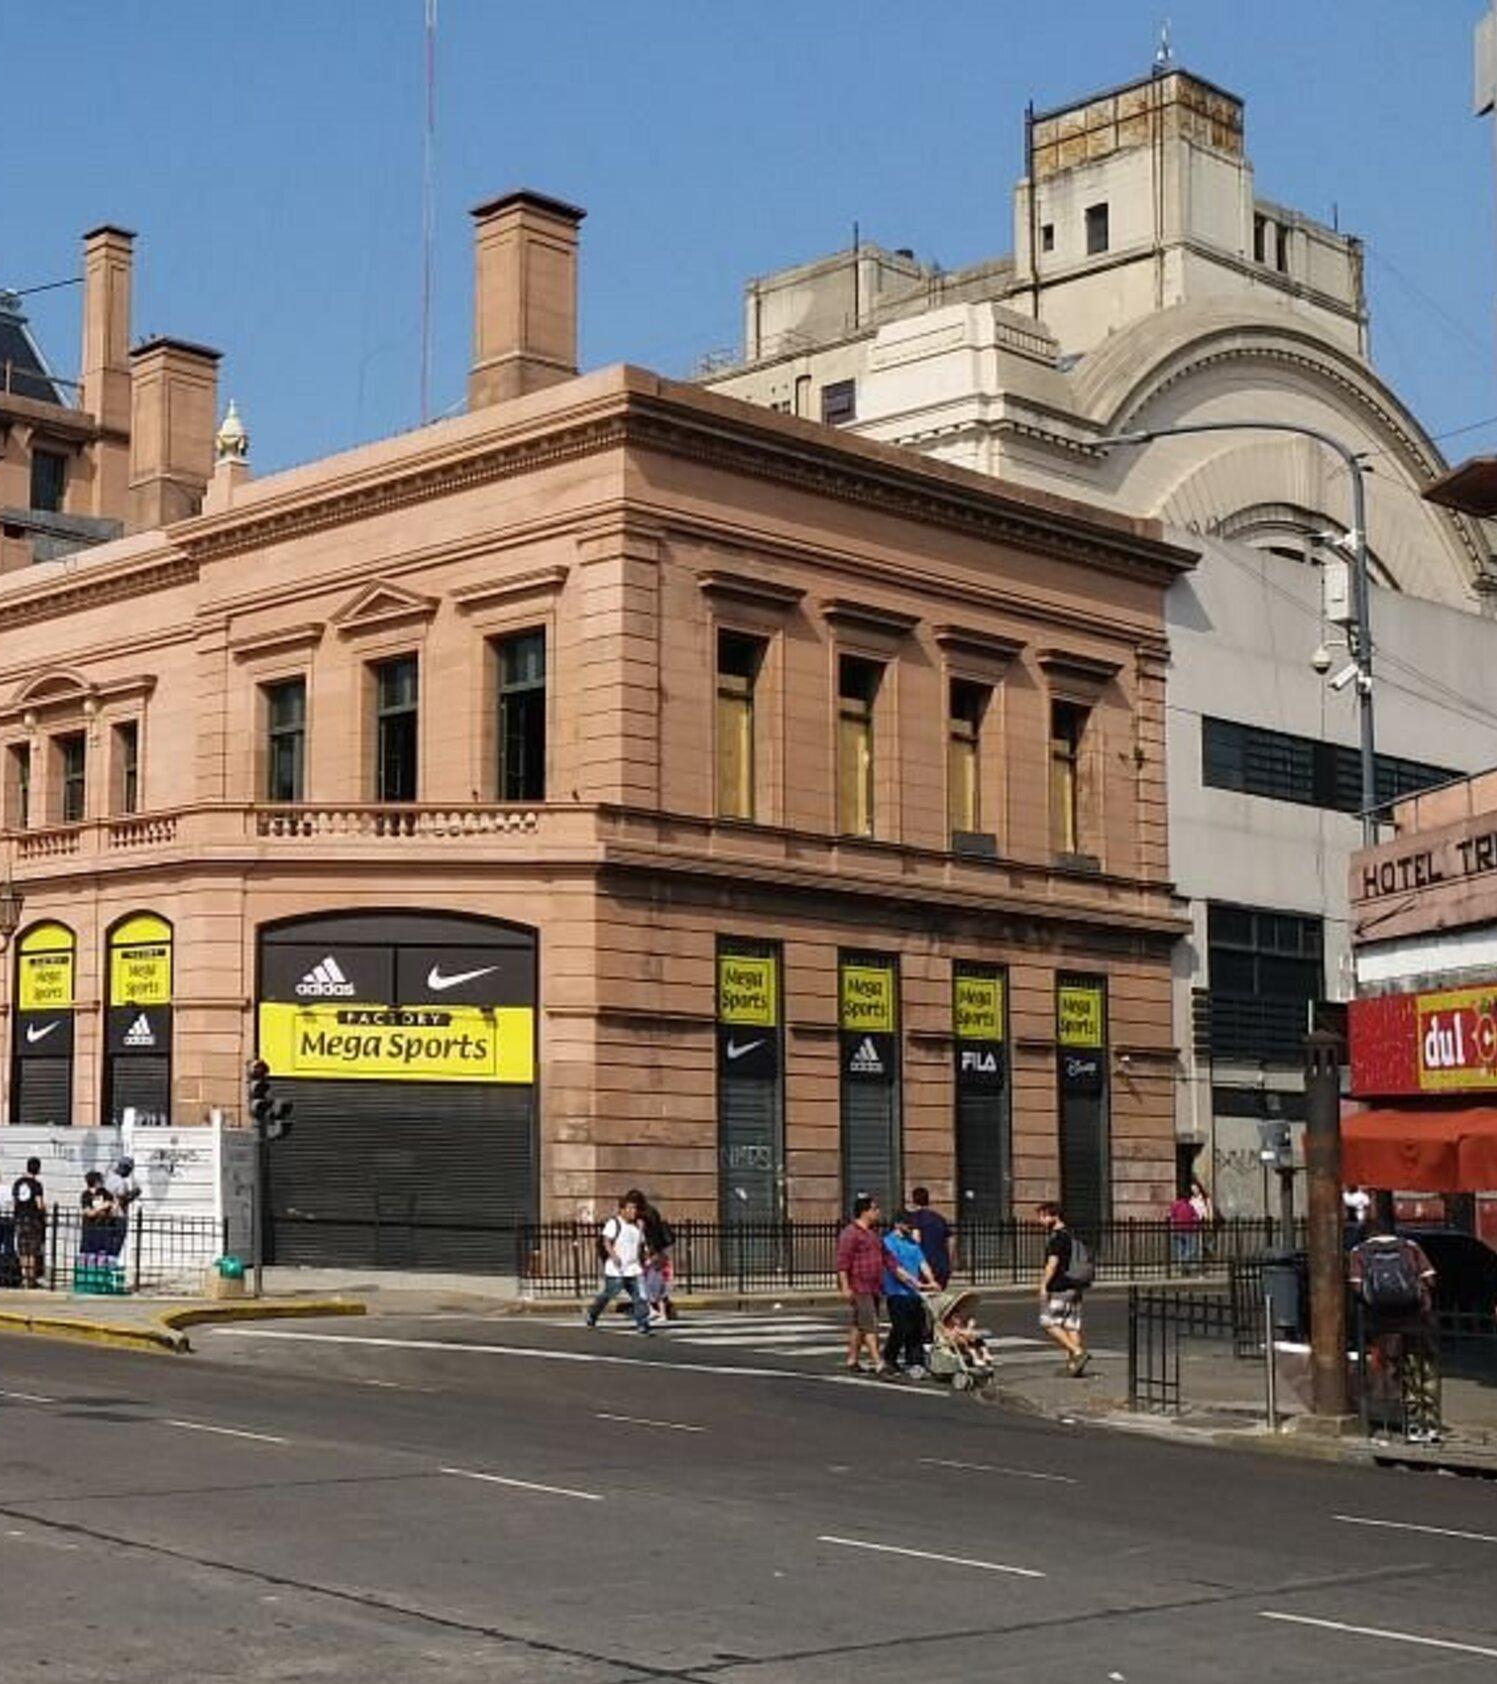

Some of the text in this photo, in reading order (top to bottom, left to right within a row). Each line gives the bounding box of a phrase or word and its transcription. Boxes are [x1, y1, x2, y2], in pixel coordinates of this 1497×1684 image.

[1363, 852, 1442, 899] HOTEL
[295, 981, 355, 996] adidas
[725, 966, 764, 990] Mega
[847, 977, 883, 998] Mega
[722, 991, 768, 1010] Sports
[346, 1013, 442, 1026] FACTORY
[300, 1031, 488, 1064] Mega Sports
[1425, 1011, 1466, 1067] dul
[961, 1052, 997, 1072] FILA
